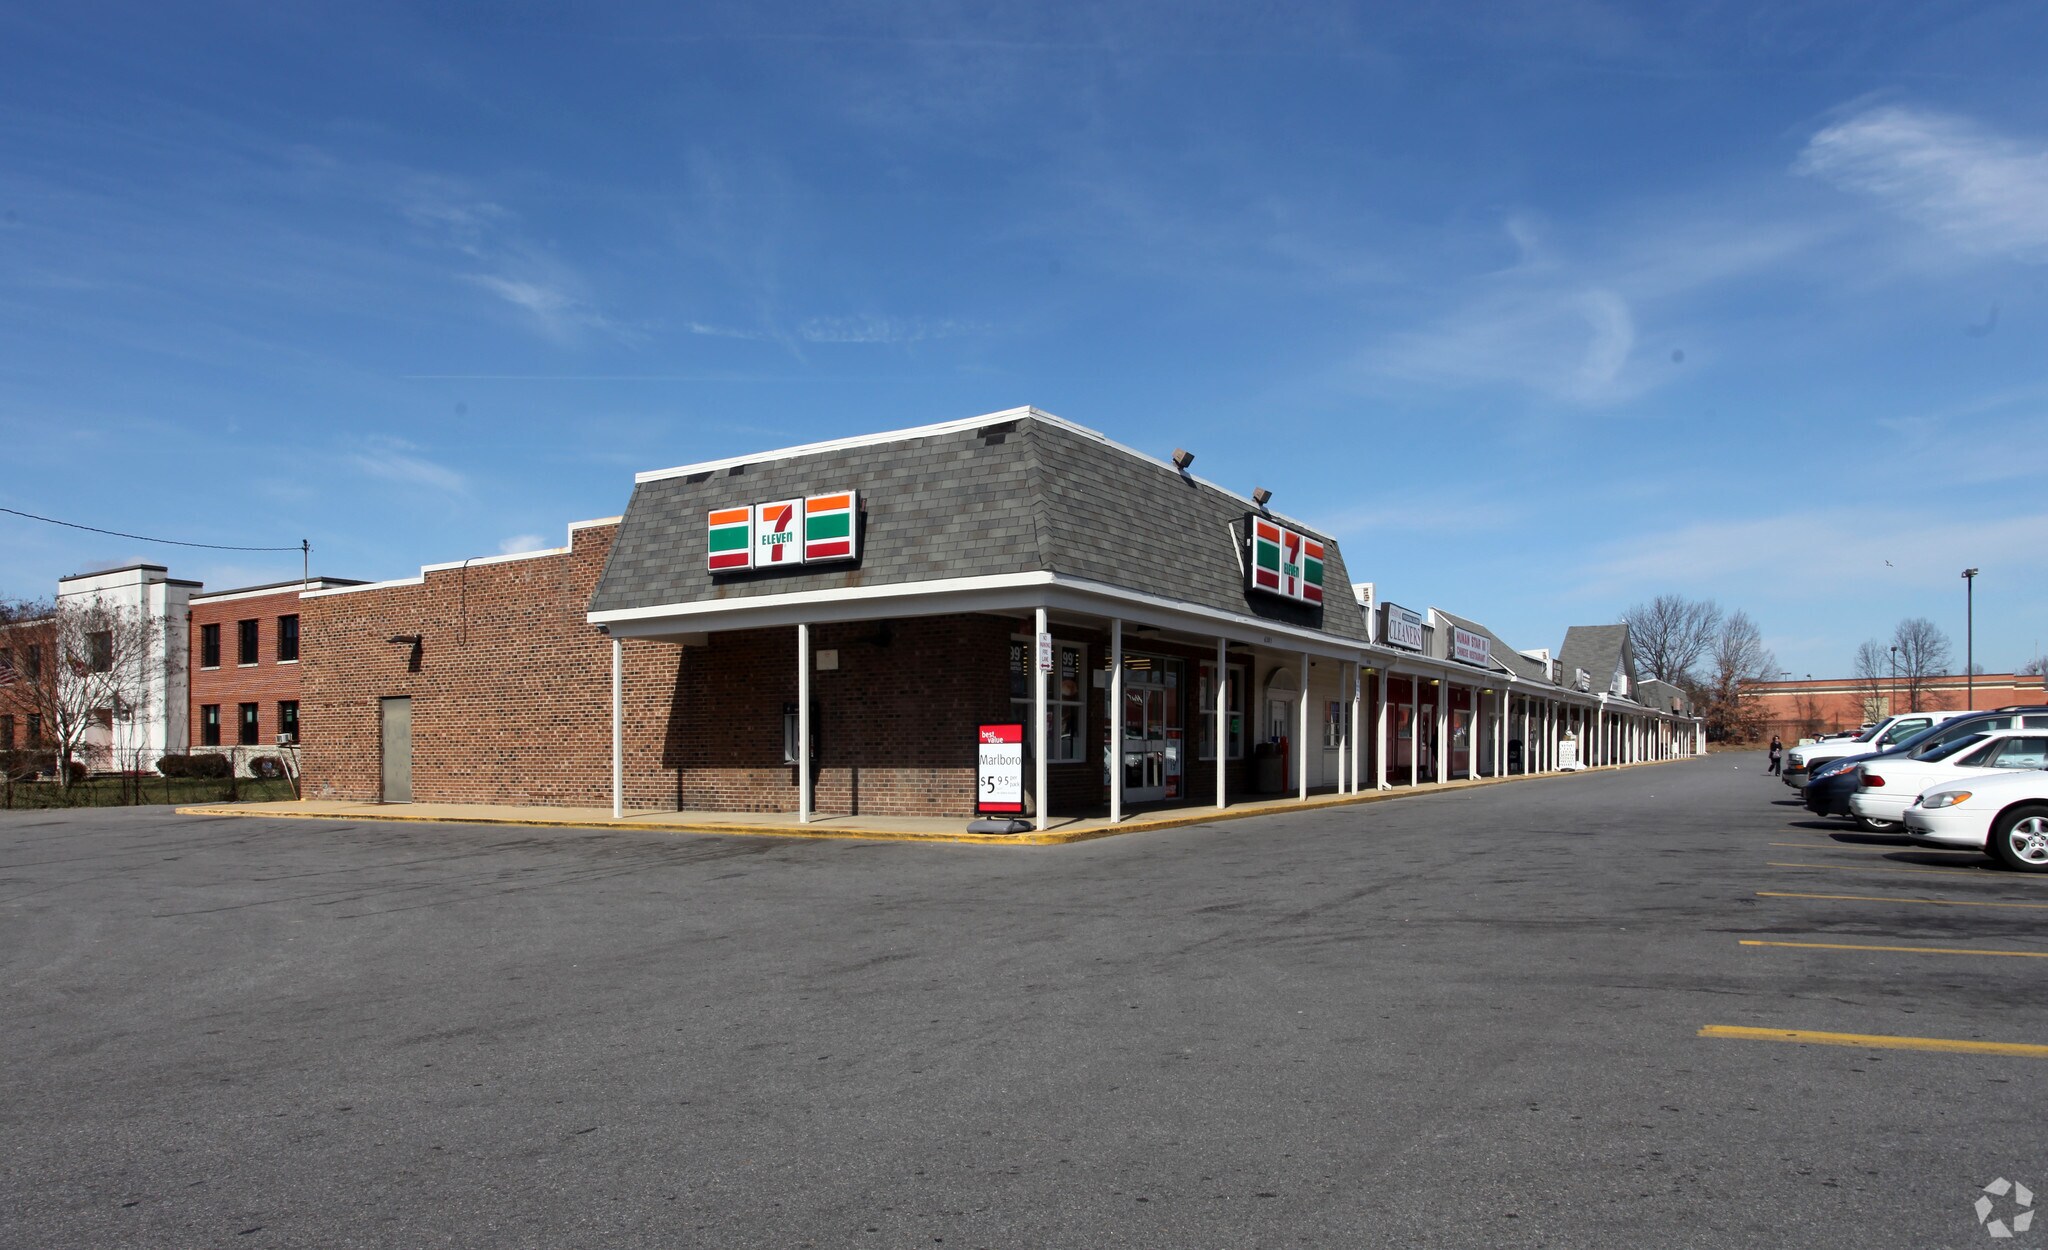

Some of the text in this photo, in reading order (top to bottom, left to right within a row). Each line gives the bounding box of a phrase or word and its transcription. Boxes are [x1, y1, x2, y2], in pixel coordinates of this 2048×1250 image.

[763, 504, 793, 562] 7
[1285, 531, 1300, 596] 7
[1389, 619, 1421, 646] CLEANERS
[979, 753, 1022, 766] Marlboro
